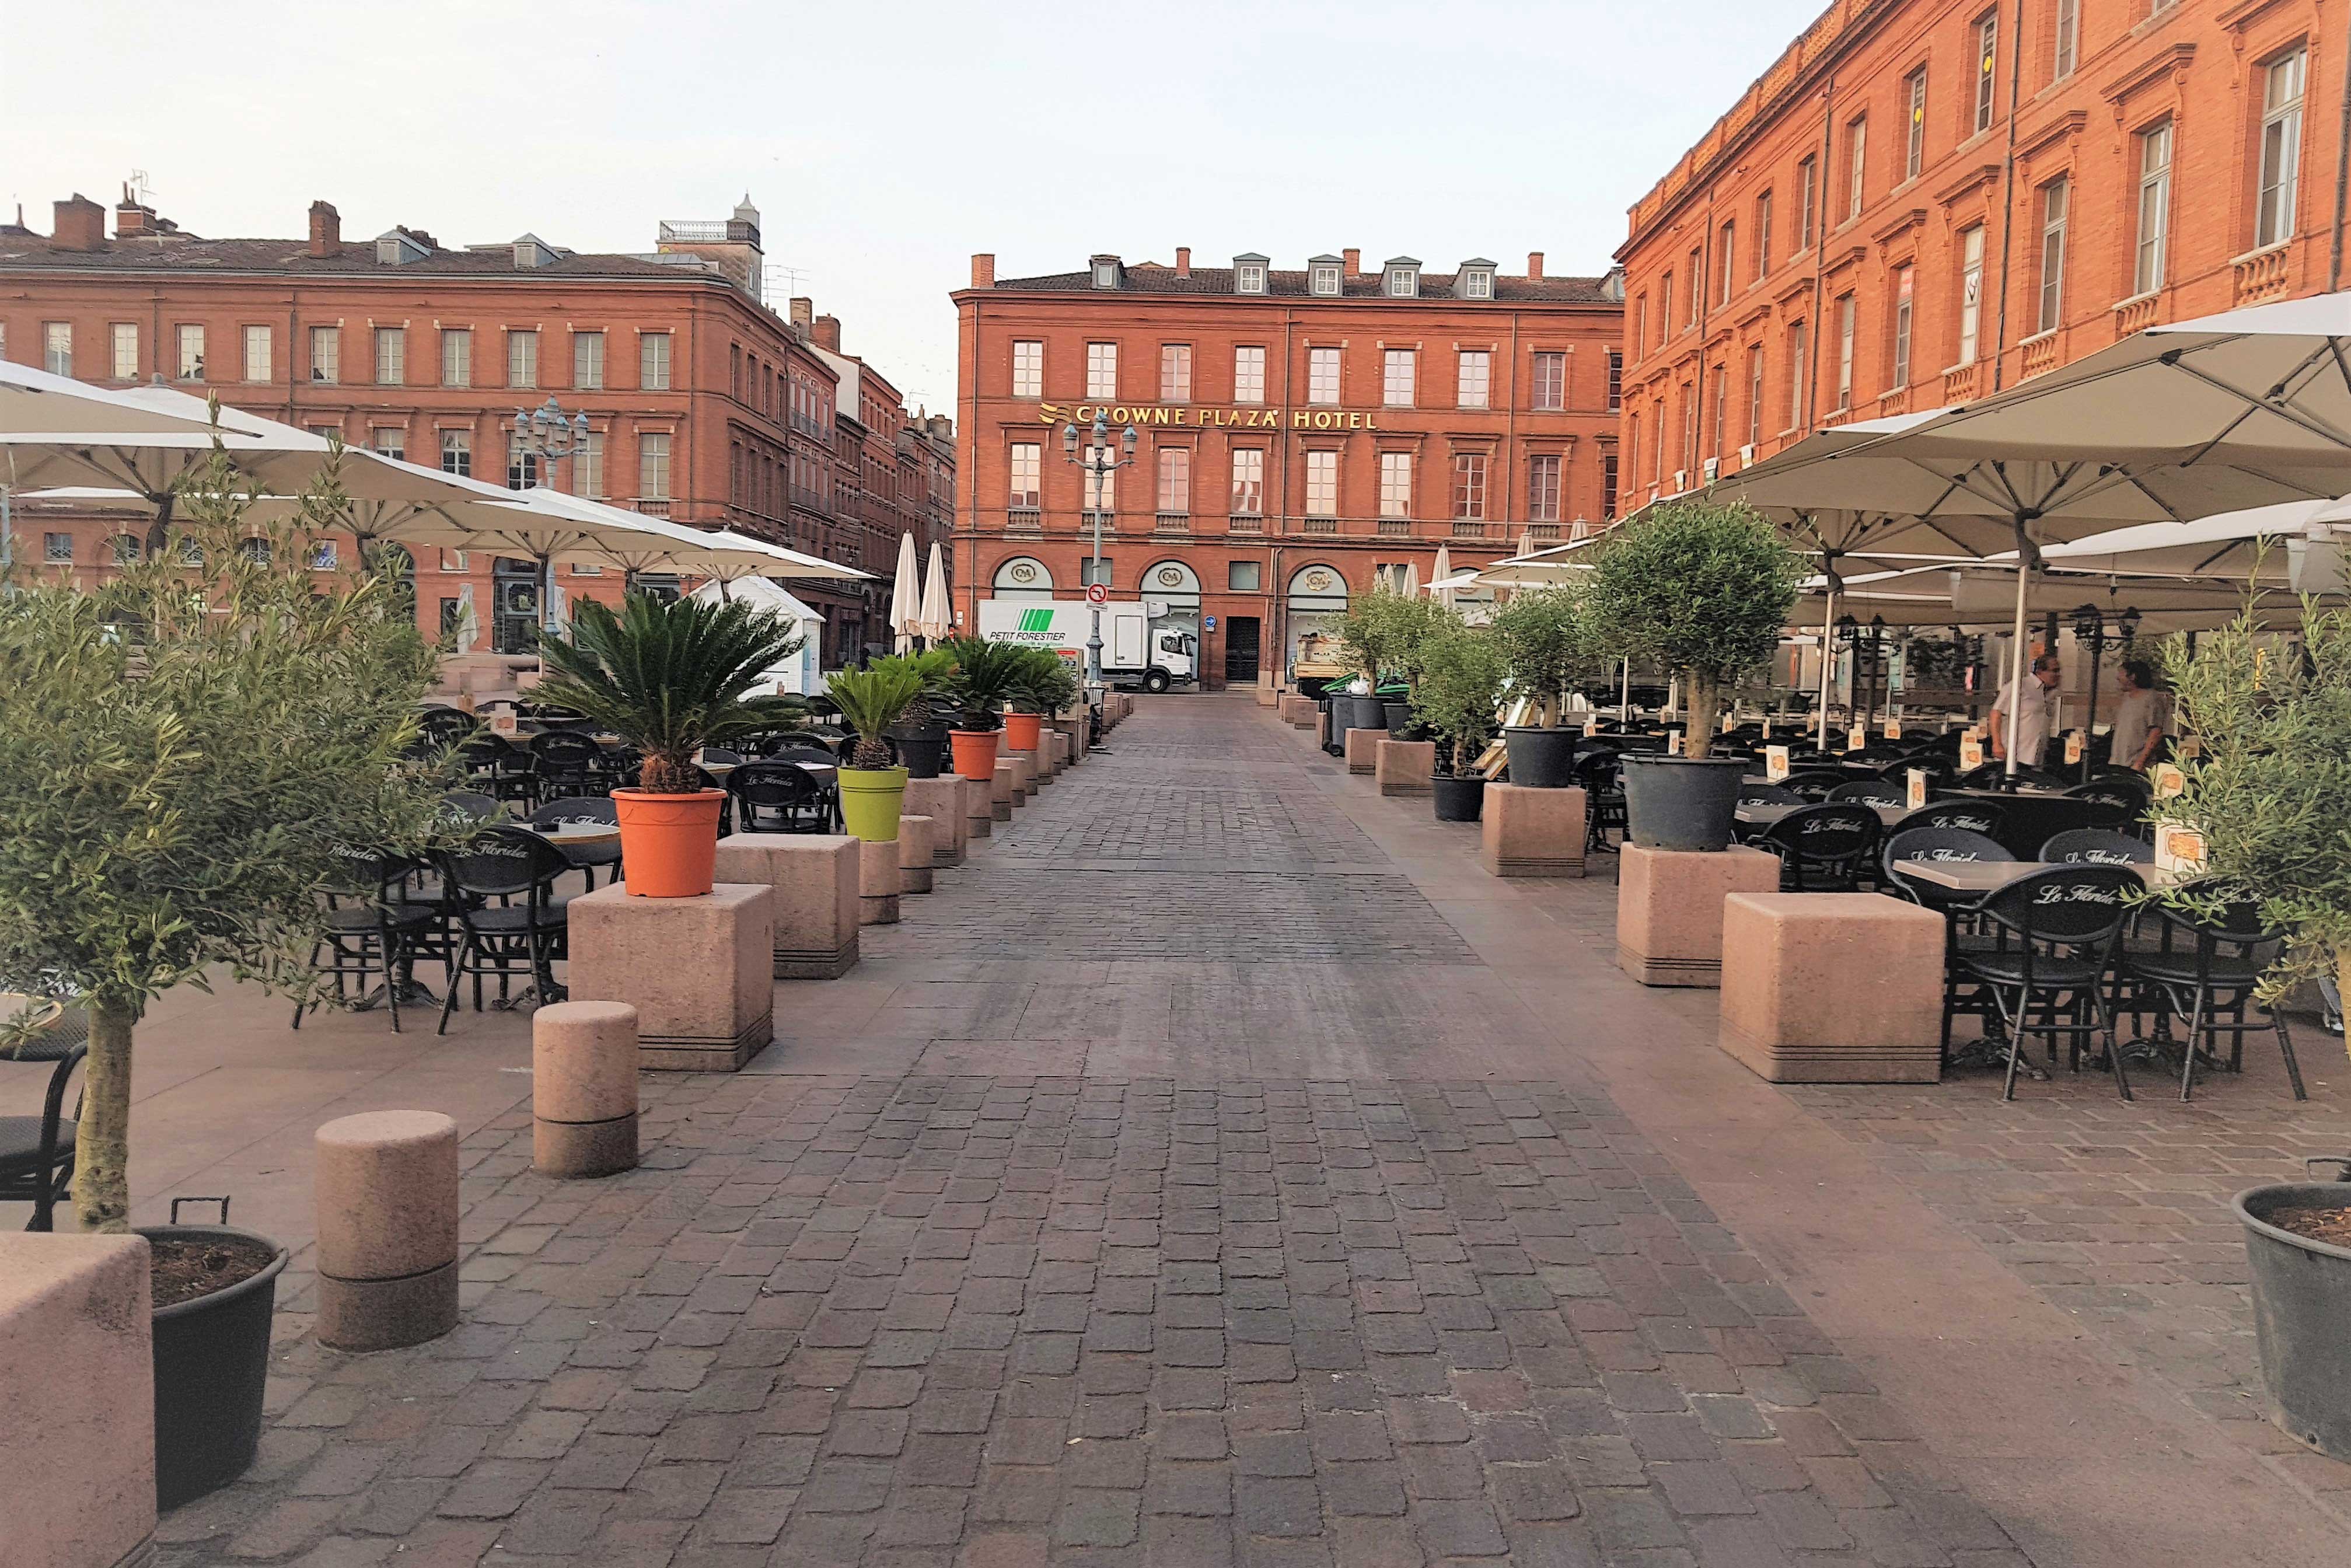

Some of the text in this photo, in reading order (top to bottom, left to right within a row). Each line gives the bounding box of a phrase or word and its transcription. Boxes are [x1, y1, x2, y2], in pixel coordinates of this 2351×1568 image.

[1294, 411, 1377, 429] HOTEL
[990, 631, 1066, 641] PETIT FORESTIER
[473, 840, 529, 858] Florida
[2032, 884, 2124, 905] Le Florida
